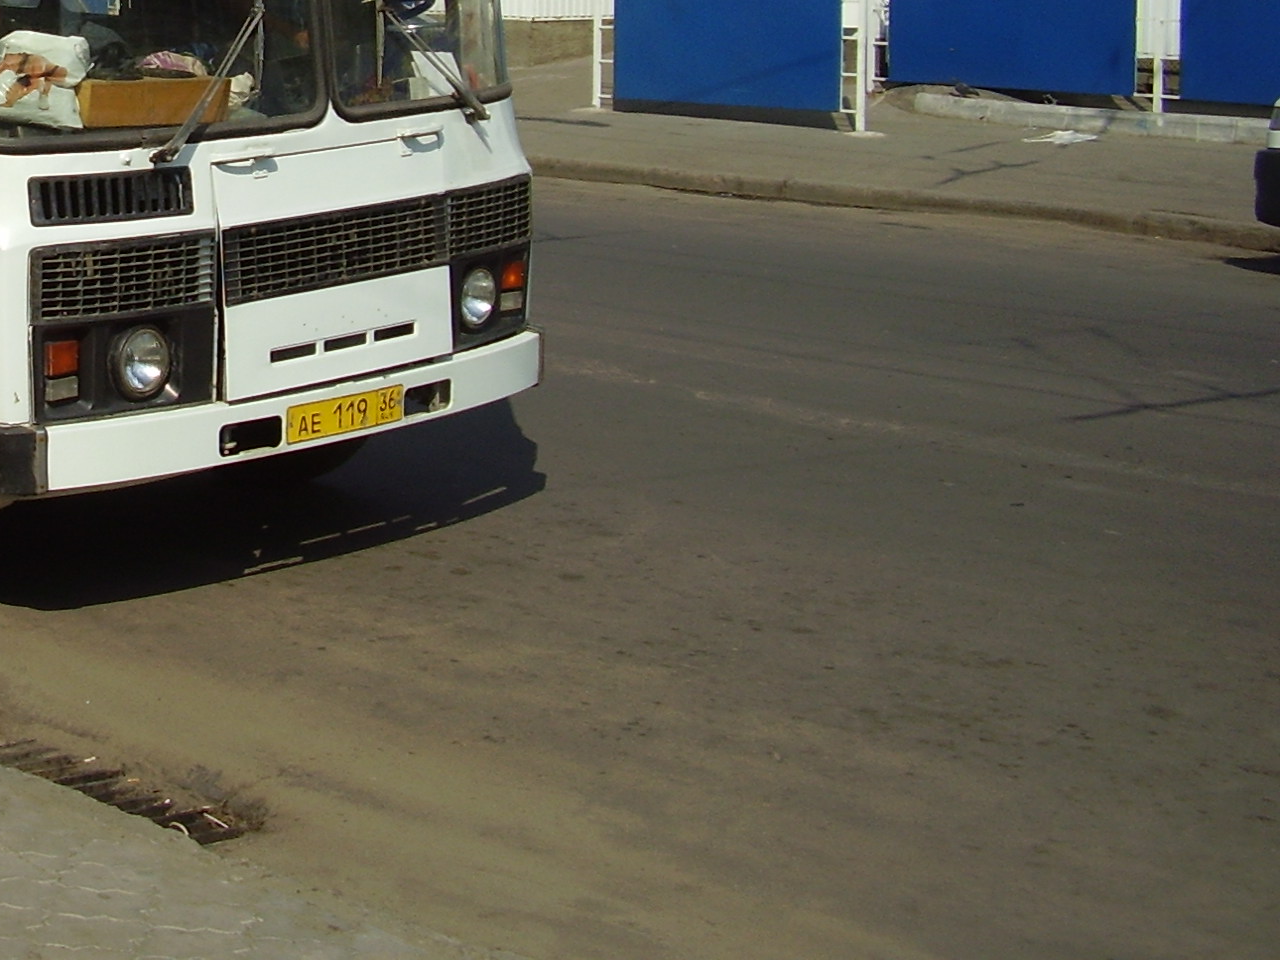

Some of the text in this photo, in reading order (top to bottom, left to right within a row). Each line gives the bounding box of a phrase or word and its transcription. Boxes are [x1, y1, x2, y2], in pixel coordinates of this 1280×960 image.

[298, 389, 397, 436] АЕ 119 36
